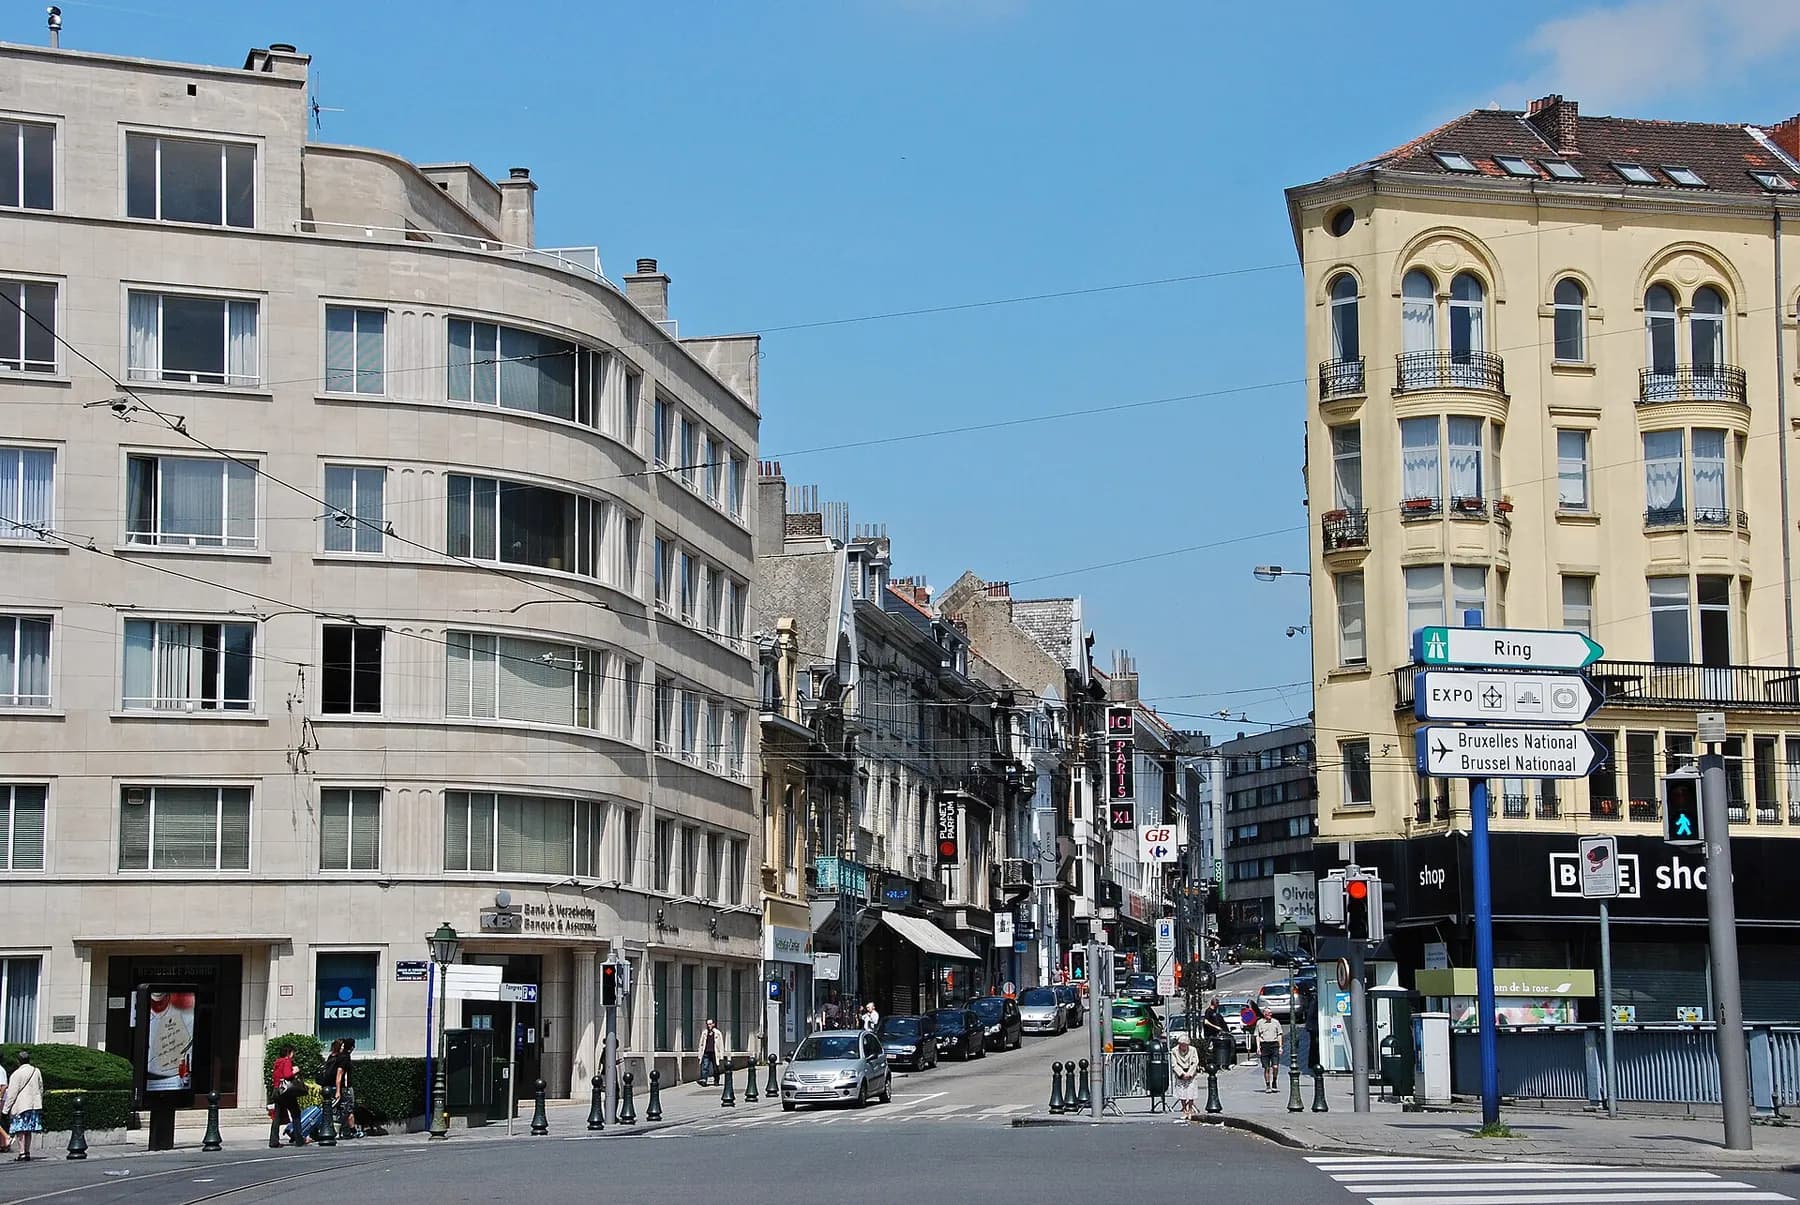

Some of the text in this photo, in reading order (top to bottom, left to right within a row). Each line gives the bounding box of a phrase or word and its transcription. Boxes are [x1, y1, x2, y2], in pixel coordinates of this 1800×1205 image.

[1494, 640, 1532, 660] Ring
[1432, 688, 1473, 703] EXPO
[1110, 715, 1132, 729] ICI
[1458, 732, 1577, 750] Bruxelles National
[1116, 740, 1127, 798] PARIS
[1461, 755, 1576, 772] Brussel Nationaal
[939, 801, 947, 839] PLANET
[947, 800, 955, 839] PARFUM
[1113, 811, 1133, 824] XL
[1145, 829, 1170, 842] GB
[1419, 864, 1445, 889] shop
[1560, 864, 1630, 887] BE
[1656, 856, 1735, 890] sho
[524, 903, 546, 917] Bank
[548, 904, 555, 916] &
[524, 918, 556, 934] Banque
[557, 919, 563, 931] &
[771, 984, 778, 993] P
[1494, 982, 1550, 993] om de la rose
[324, 1006, 366, 1019] KBC
